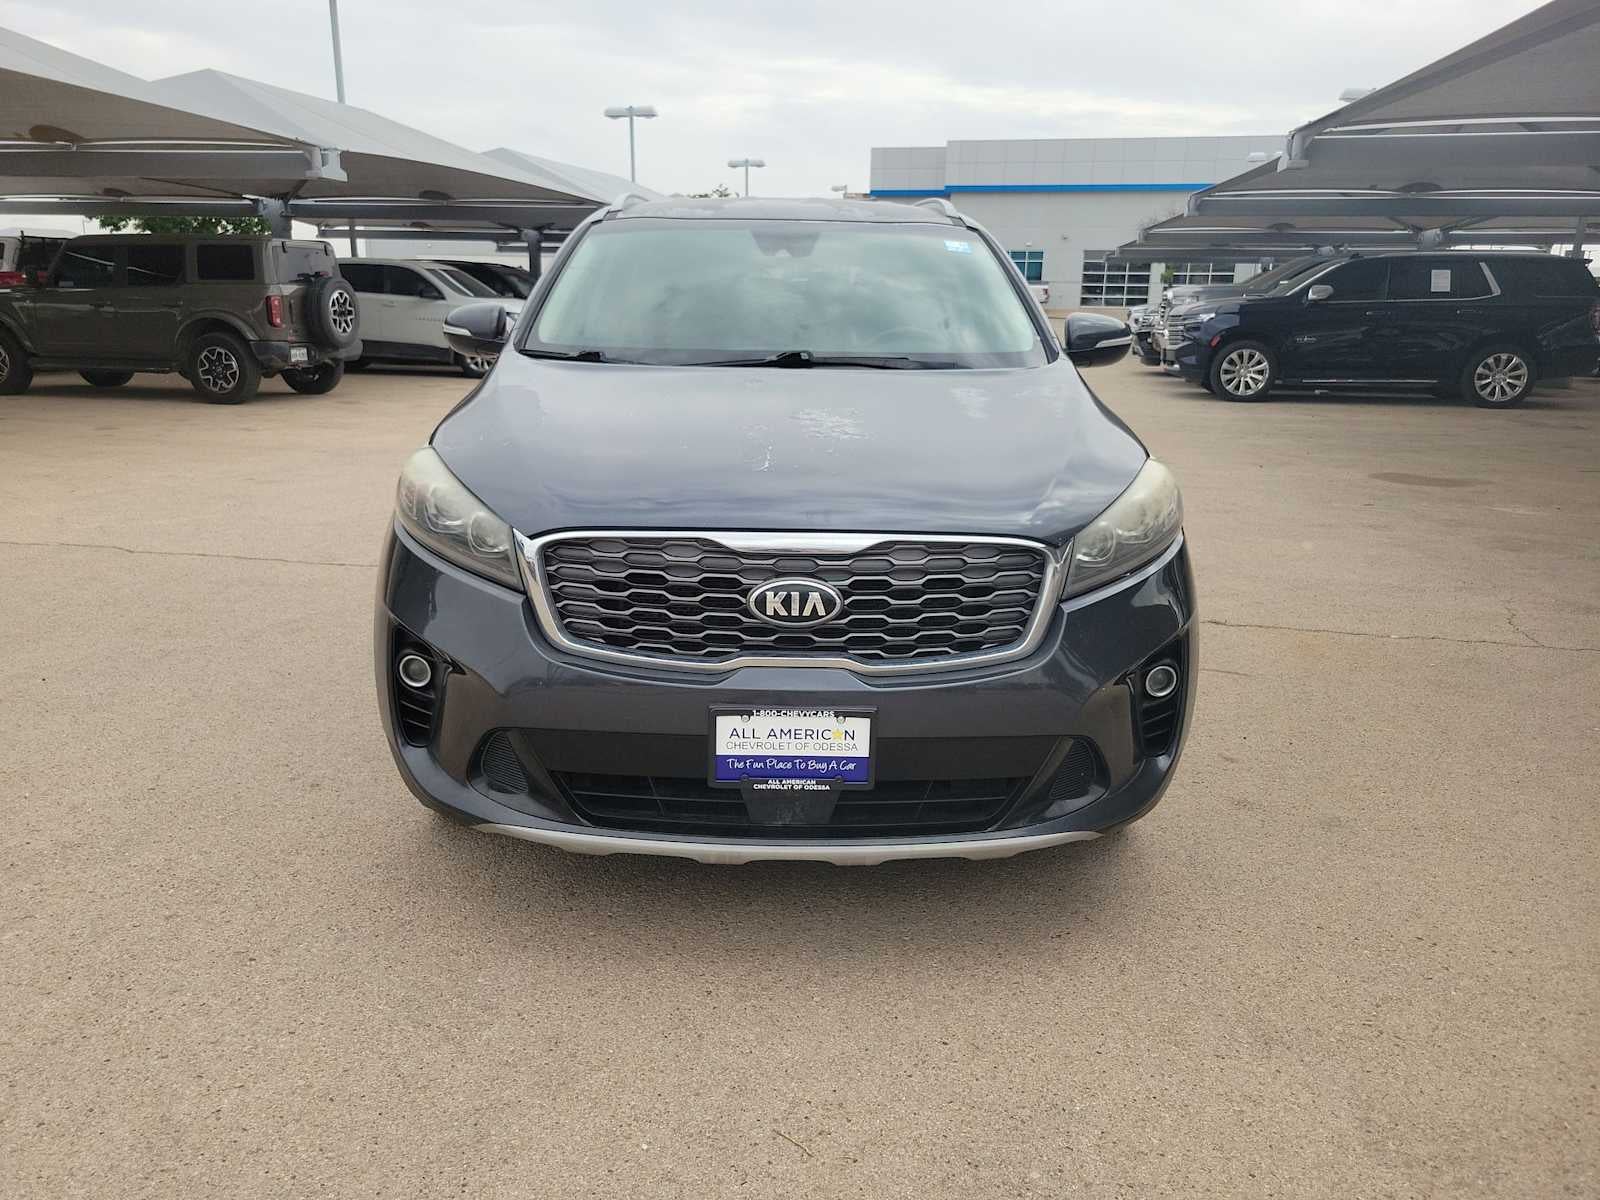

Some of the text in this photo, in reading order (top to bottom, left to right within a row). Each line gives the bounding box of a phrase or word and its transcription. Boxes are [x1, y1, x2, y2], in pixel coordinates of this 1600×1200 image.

[765, 591, 826, 617] KIA
[752, 710, 835, 718] 1-800-CHEVYCARS
[729, 727, 855, 741] ALL AMERICN
[726, 741, 858, 752] CHEVROLET OF ODESSA
[726, 758, 857, 774] The Fun Place To Buy A Car
